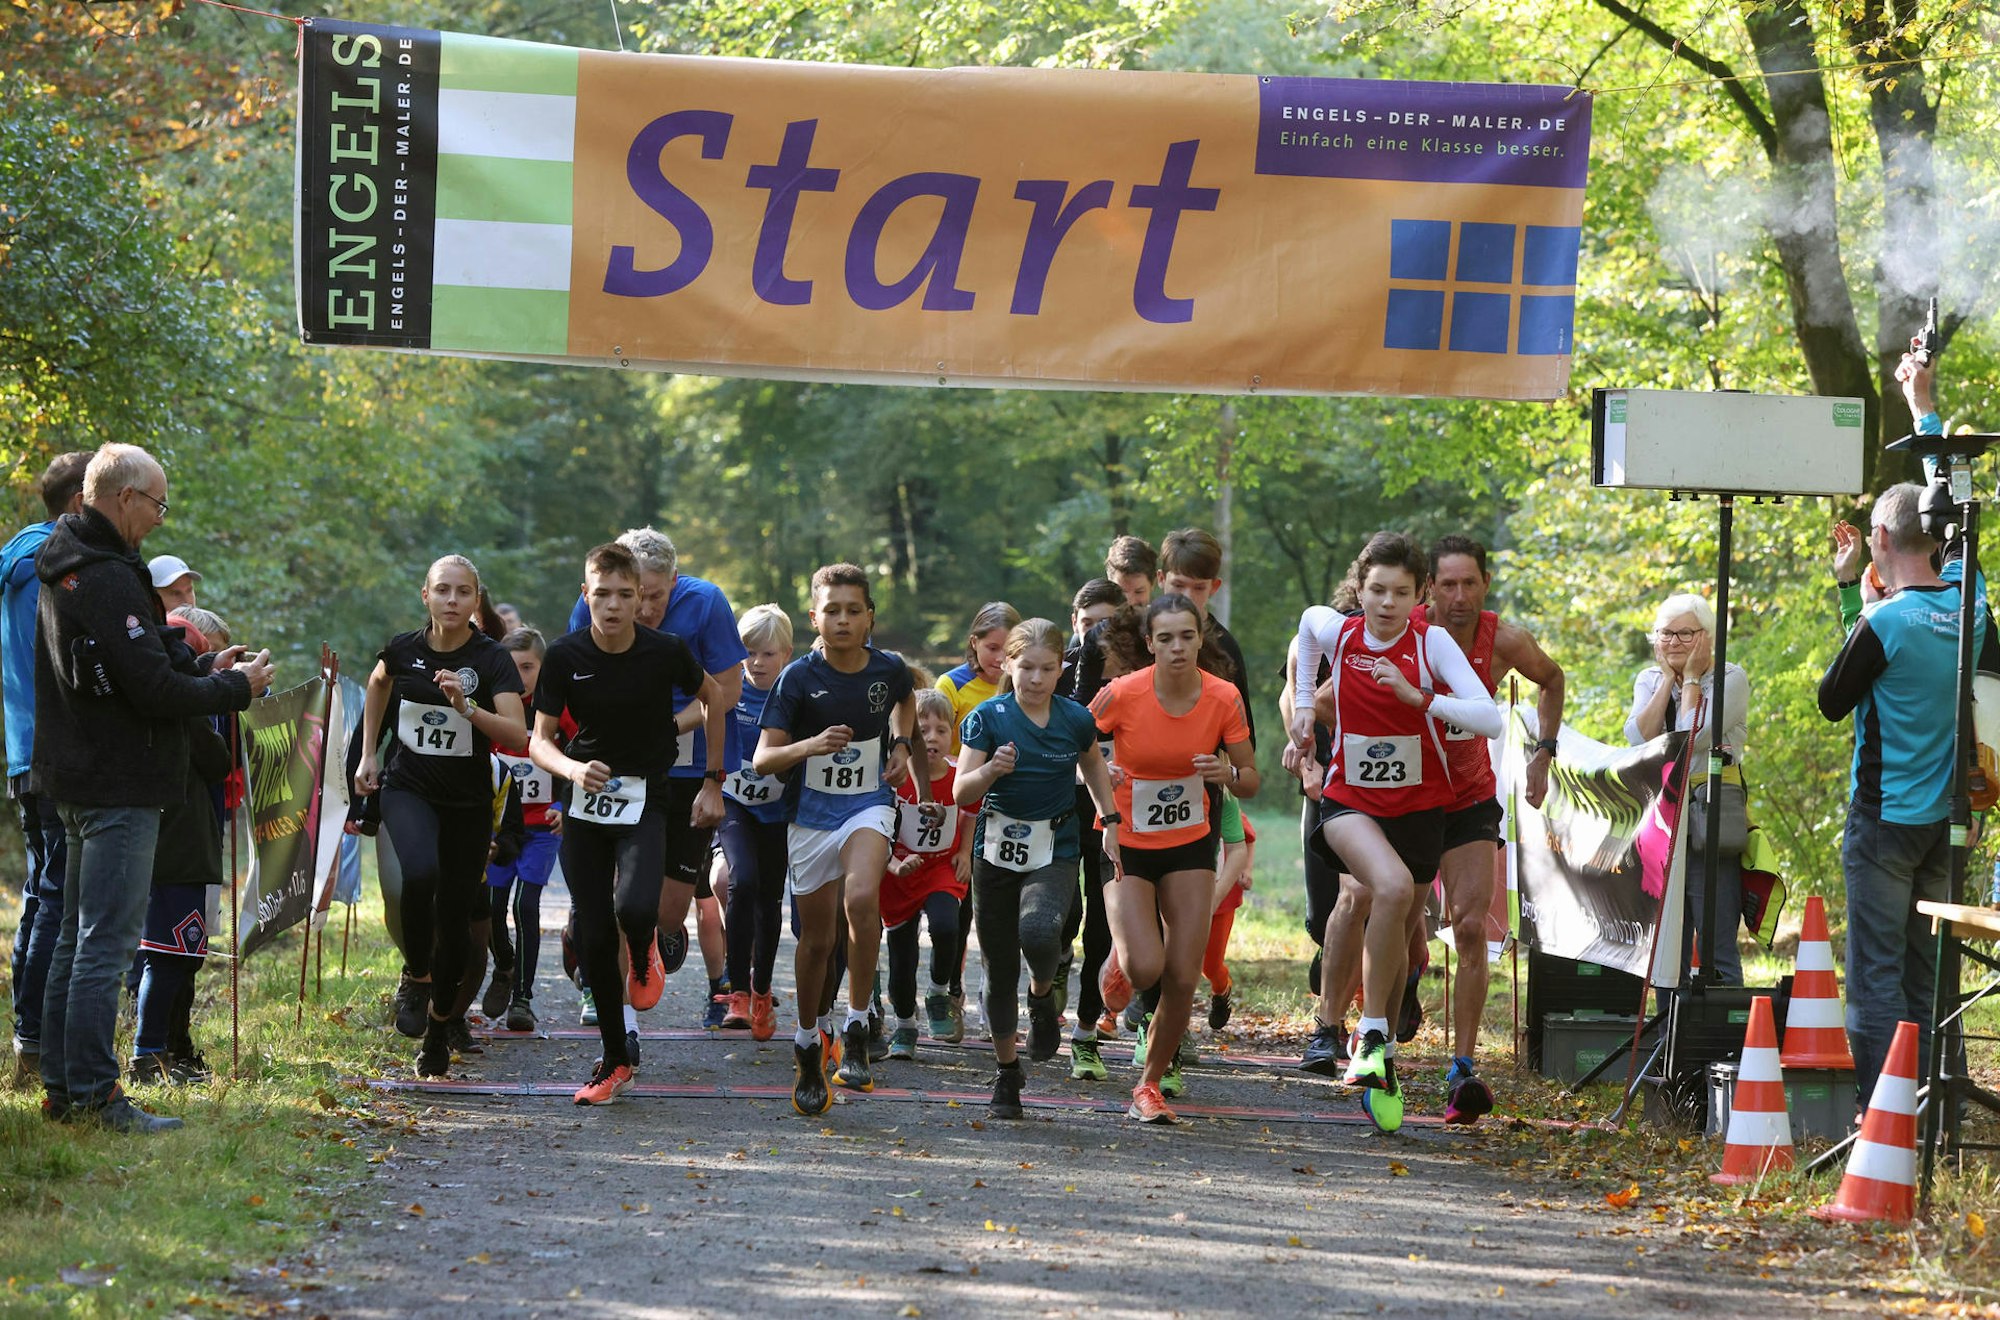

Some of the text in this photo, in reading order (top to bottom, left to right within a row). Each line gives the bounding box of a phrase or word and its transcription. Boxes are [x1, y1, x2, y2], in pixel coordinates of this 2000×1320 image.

[1280, 131, 1564, 157] Einfach eine Klasse besser.
[328, 33, 382, 331] ENGELS
[602, 109, 1222, 324] Start
[870, 704, 885, 714] LAV
[414, 726, 457, 750] 147
[822, 766, 864, 789] 181
[1359, 761, 1406, 782] 223
[733, 778, 770, 801] 144
[583, 792, 629, 817] 267
[1147, 800, 1191, 825] 266
[917, 828, 942, 847] 79
[1000, 840, 1029, 866] 85
